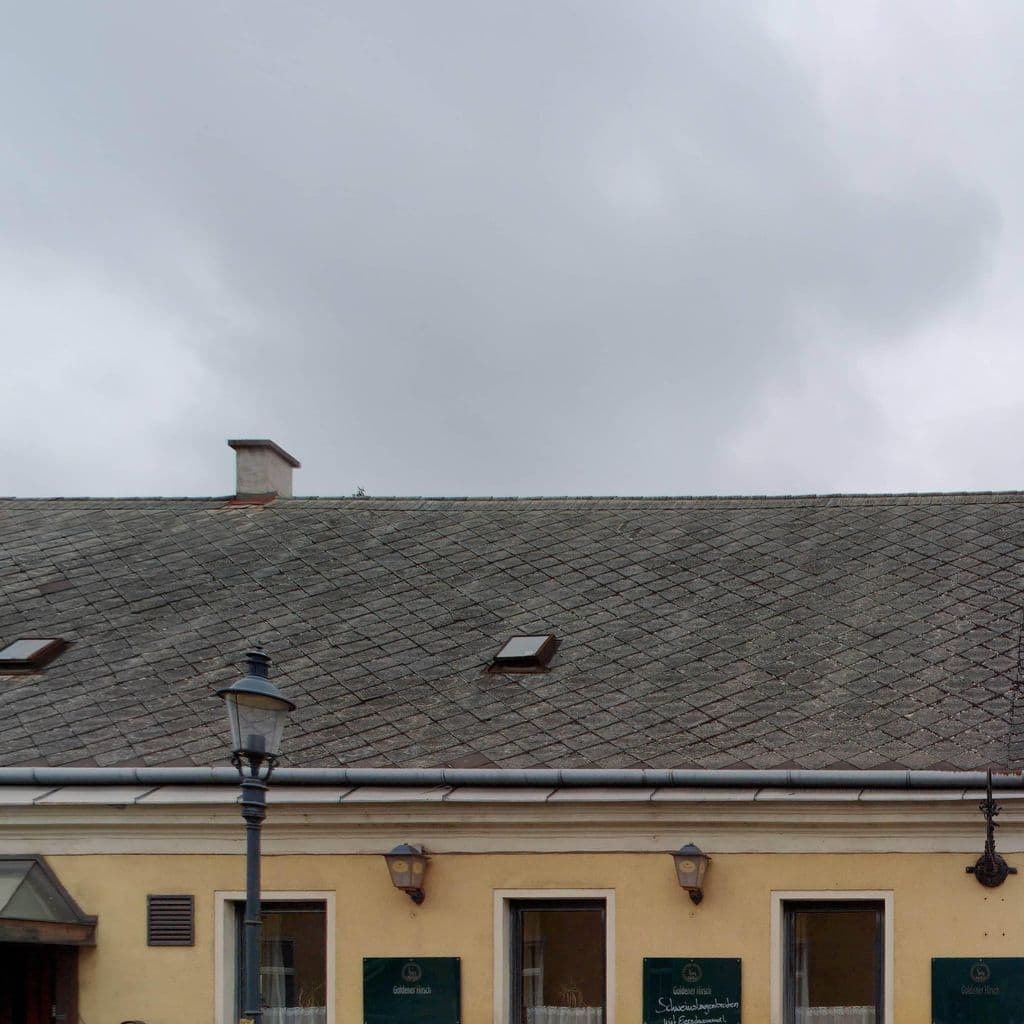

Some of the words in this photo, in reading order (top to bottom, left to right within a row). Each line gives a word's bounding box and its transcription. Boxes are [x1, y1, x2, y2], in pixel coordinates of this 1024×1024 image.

[393, 985, 415, 994] Goldener
[416, 985, 431, 994] Hirsch
[673, 985, 695, 995] Goldener
[696, 985, 711, 995] Hirsch
